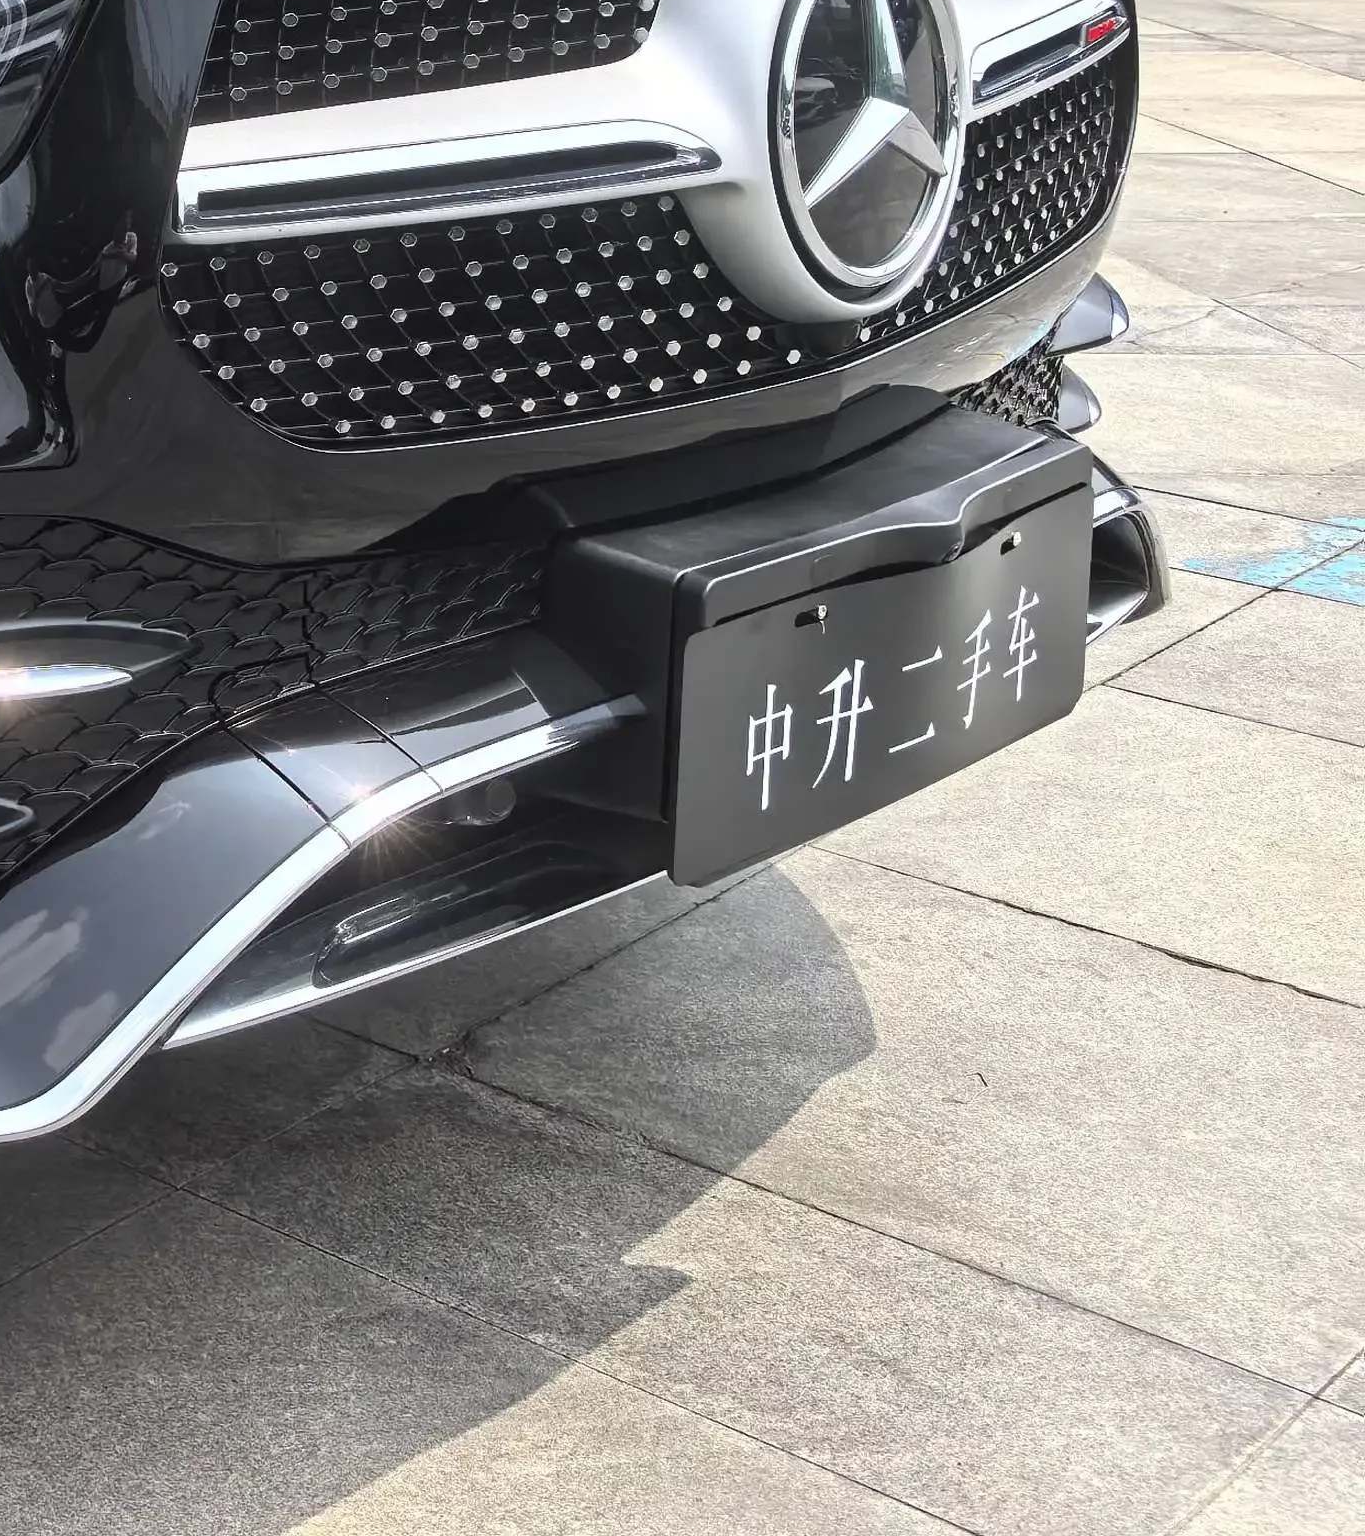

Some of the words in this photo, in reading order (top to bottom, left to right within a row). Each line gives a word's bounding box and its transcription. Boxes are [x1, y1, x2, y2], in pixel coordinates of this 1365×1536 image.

[746, 585, 1040, 811] 中升二手车
